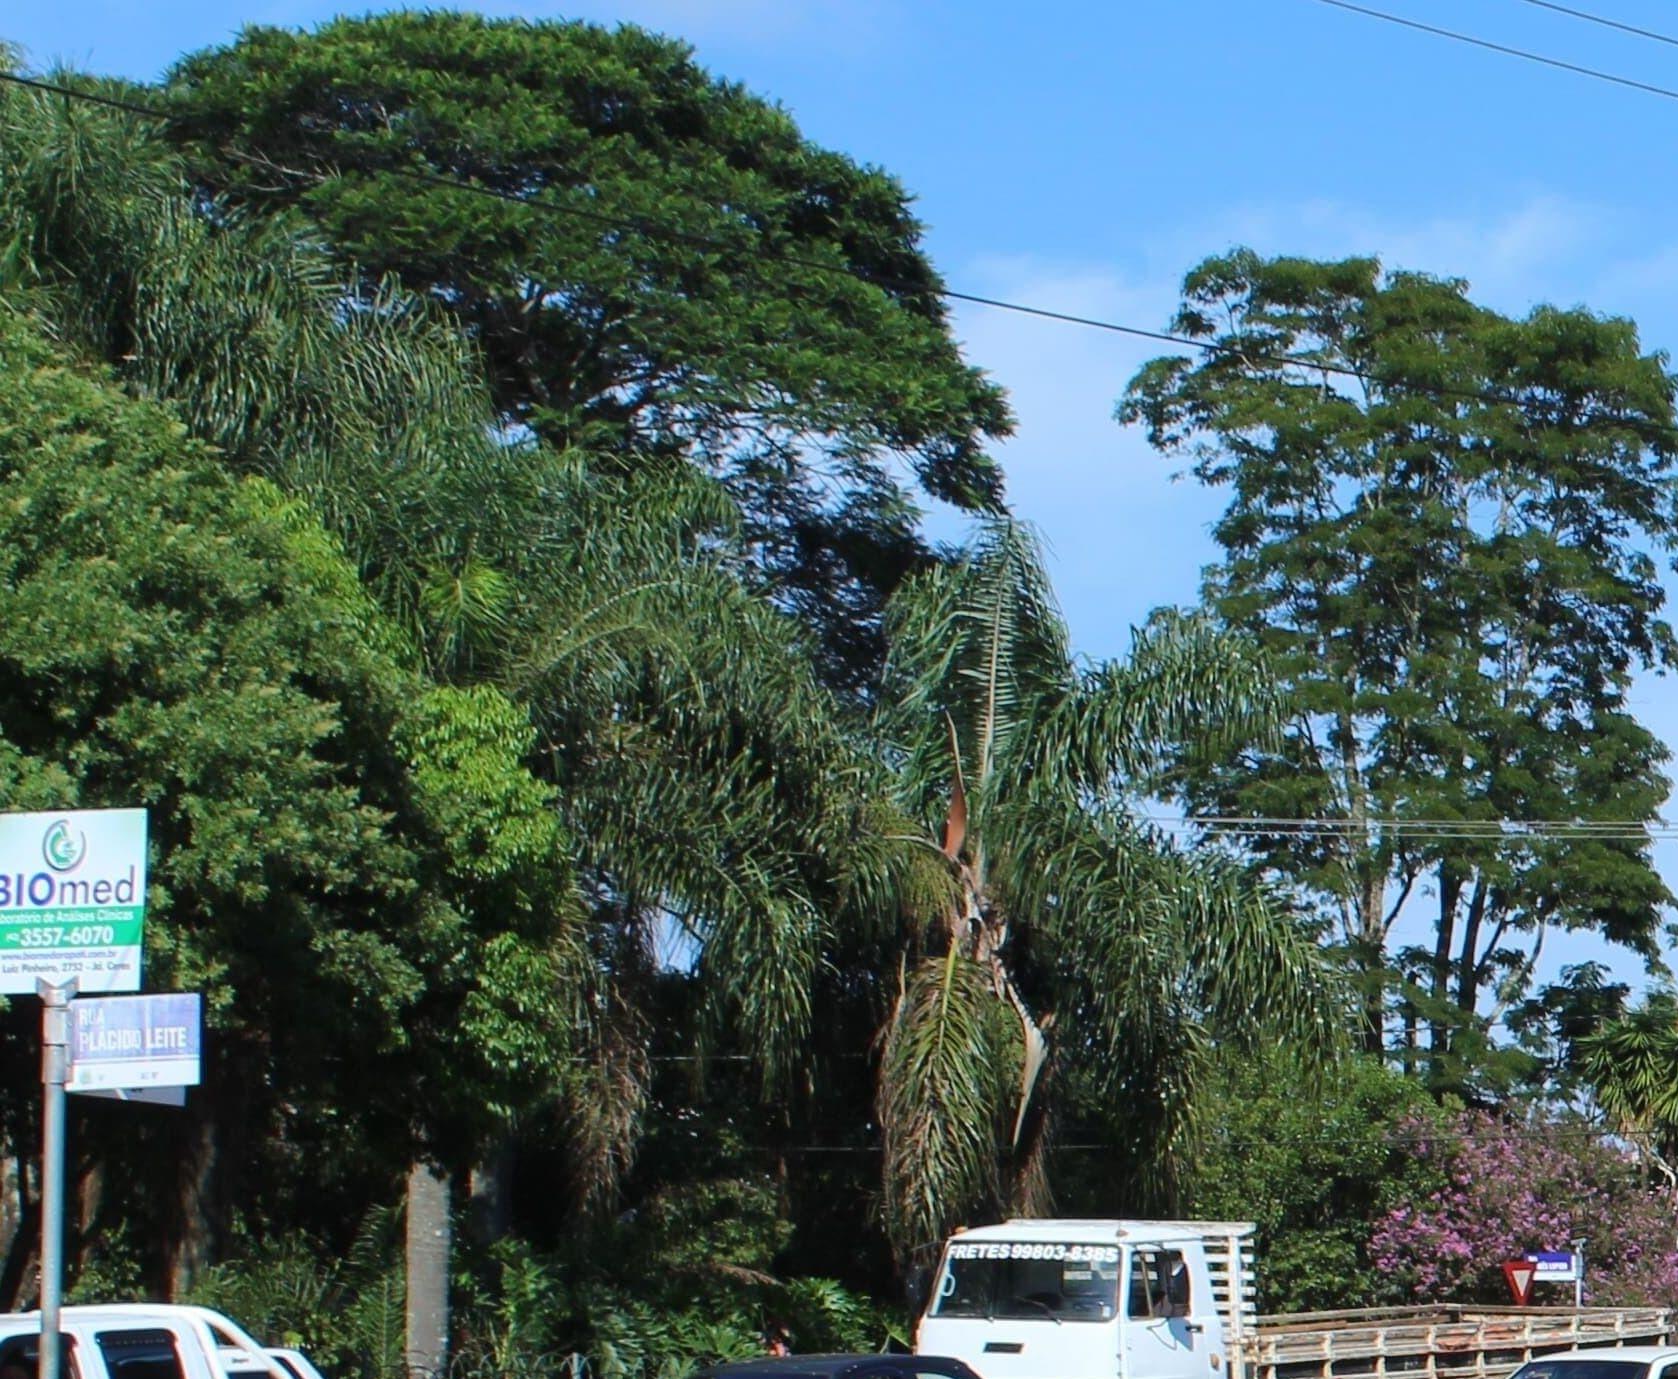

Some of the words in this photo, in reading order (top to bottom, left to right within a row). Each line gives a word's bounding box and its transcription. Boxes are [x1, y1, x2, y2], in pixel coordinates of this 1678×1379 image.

[43, 912, 54, 921] de
[20, 925, 114, 946] 3557-6070
[79, 1008, 105, 1025] RUA
[146, 1027, 187, 1048] LEITE
[949, 1244, 1010, 1260] FRETES
